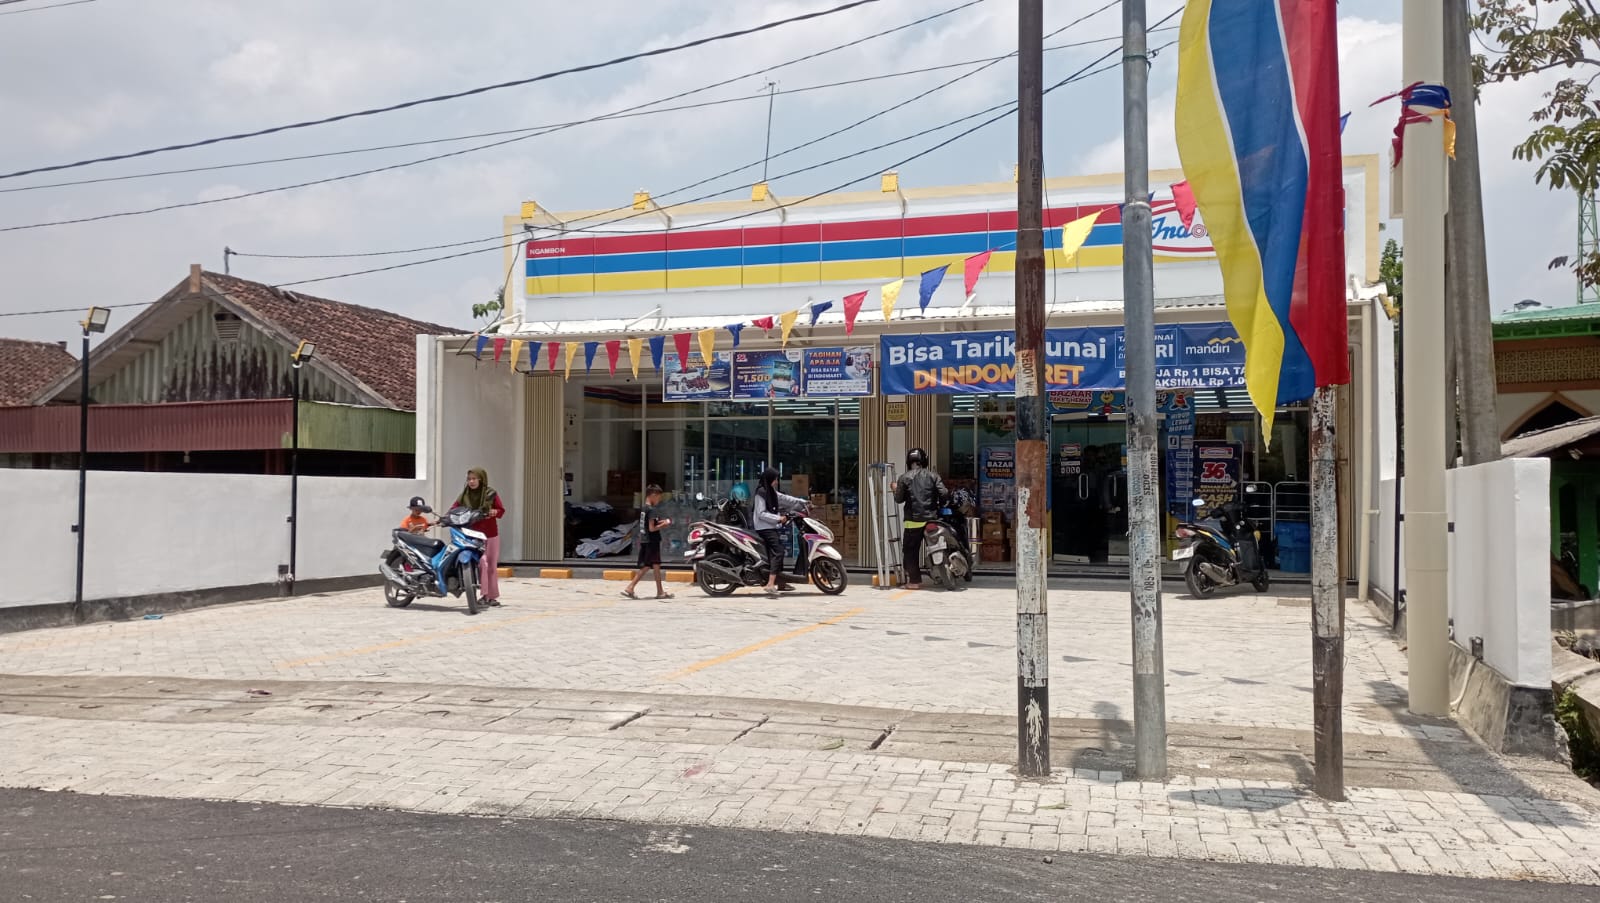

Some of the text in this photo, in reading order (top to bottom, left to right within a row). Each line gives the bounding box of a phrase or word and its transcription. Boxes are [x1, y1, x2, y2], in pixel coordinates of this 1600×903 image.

[889, 336, 1106, 365] Bisa Tarik unai
[1155, 343, 1174, 358] RI
[743, 374, 770, 383] 1.500
[913, 363, 1085, 389] DI INDOMRET
[1174, 368, 1189, 377] Rp
[1193, 368, 1198, 376] 1
[1202, 367, 1230, 376] BISA
[1155, 377, 1206, 387] AKSIMAL
[1209, 377, 1224, 386] Rp
[1201, 462, 1227, 479] 36
[1142, 473, 1151, 496] SEDO
